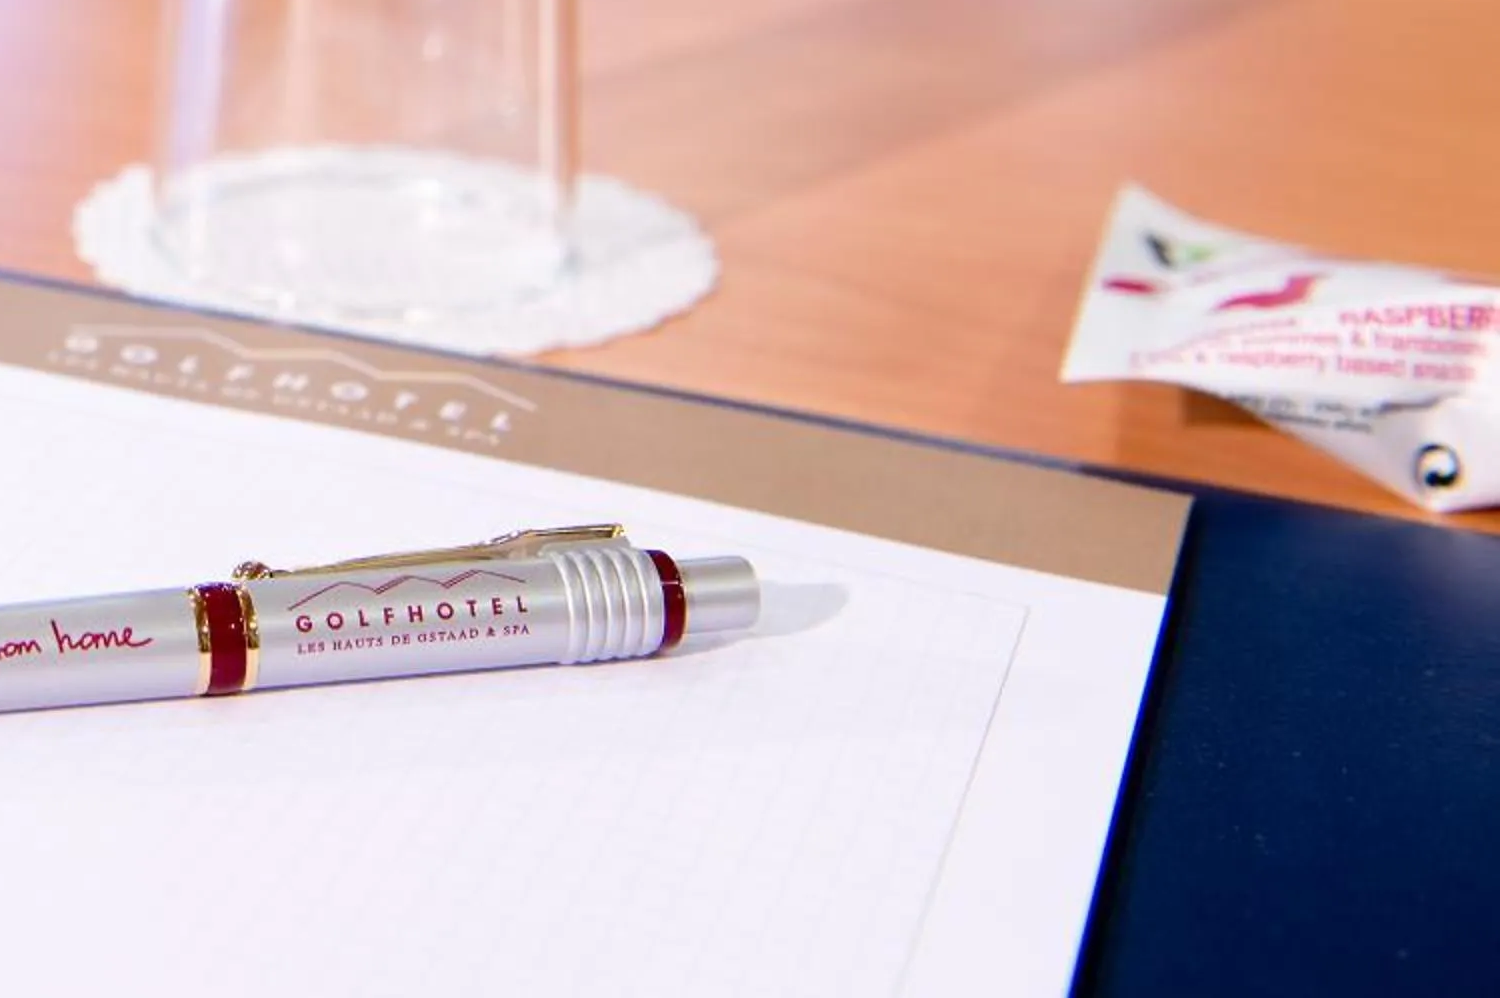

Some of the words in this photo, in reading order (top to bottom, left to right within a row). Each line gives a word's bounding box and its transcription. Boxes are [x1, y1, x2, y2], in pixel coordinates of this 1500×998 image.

[296, 596, 528, 633] GOLFHOTEL
[51, 619, 153, 654] home
[297, 642, 325, 655] LES
[333, 636, 384, 651] HAUTS
[391, 634, 411, 645] DE
[485, 627, 496, 637] &
[503, 623, 530, 636] SPA
